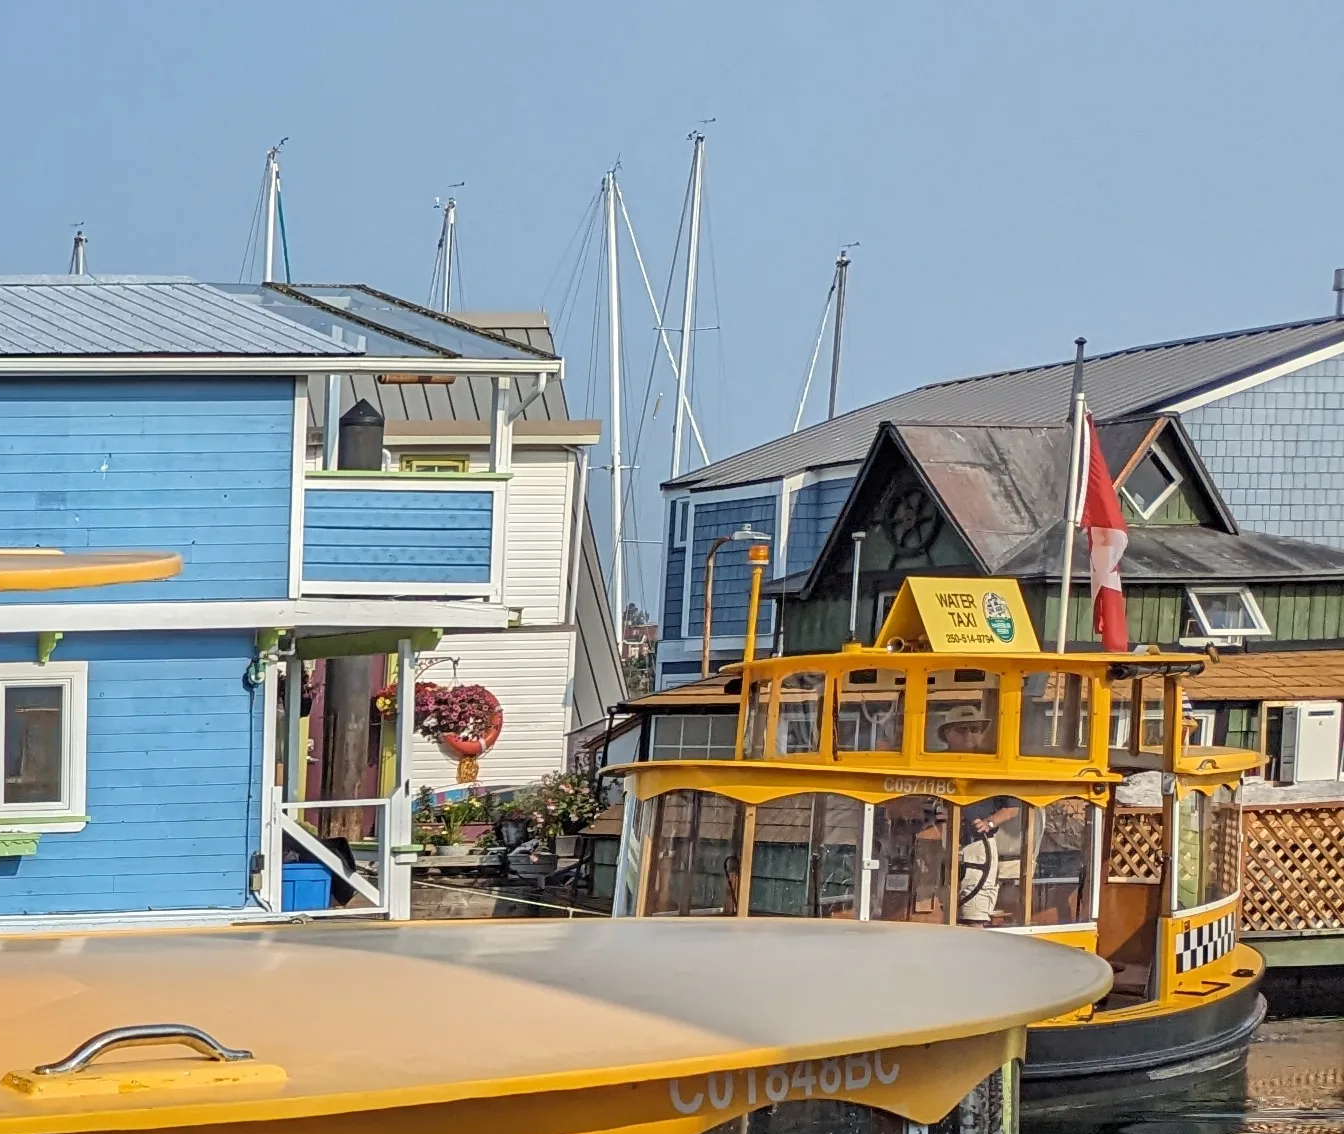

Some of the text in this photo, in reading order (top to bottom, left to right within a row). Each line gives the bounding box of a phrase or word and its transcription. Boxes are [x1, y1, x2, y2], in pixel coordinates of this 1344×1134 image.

[934, 592, 978, 610] WATER
[947, 611, 978, 628] TAXI
[945, 633, 995, 644] 250-514-9794
[883, 776, 957, 795] C05711BC
